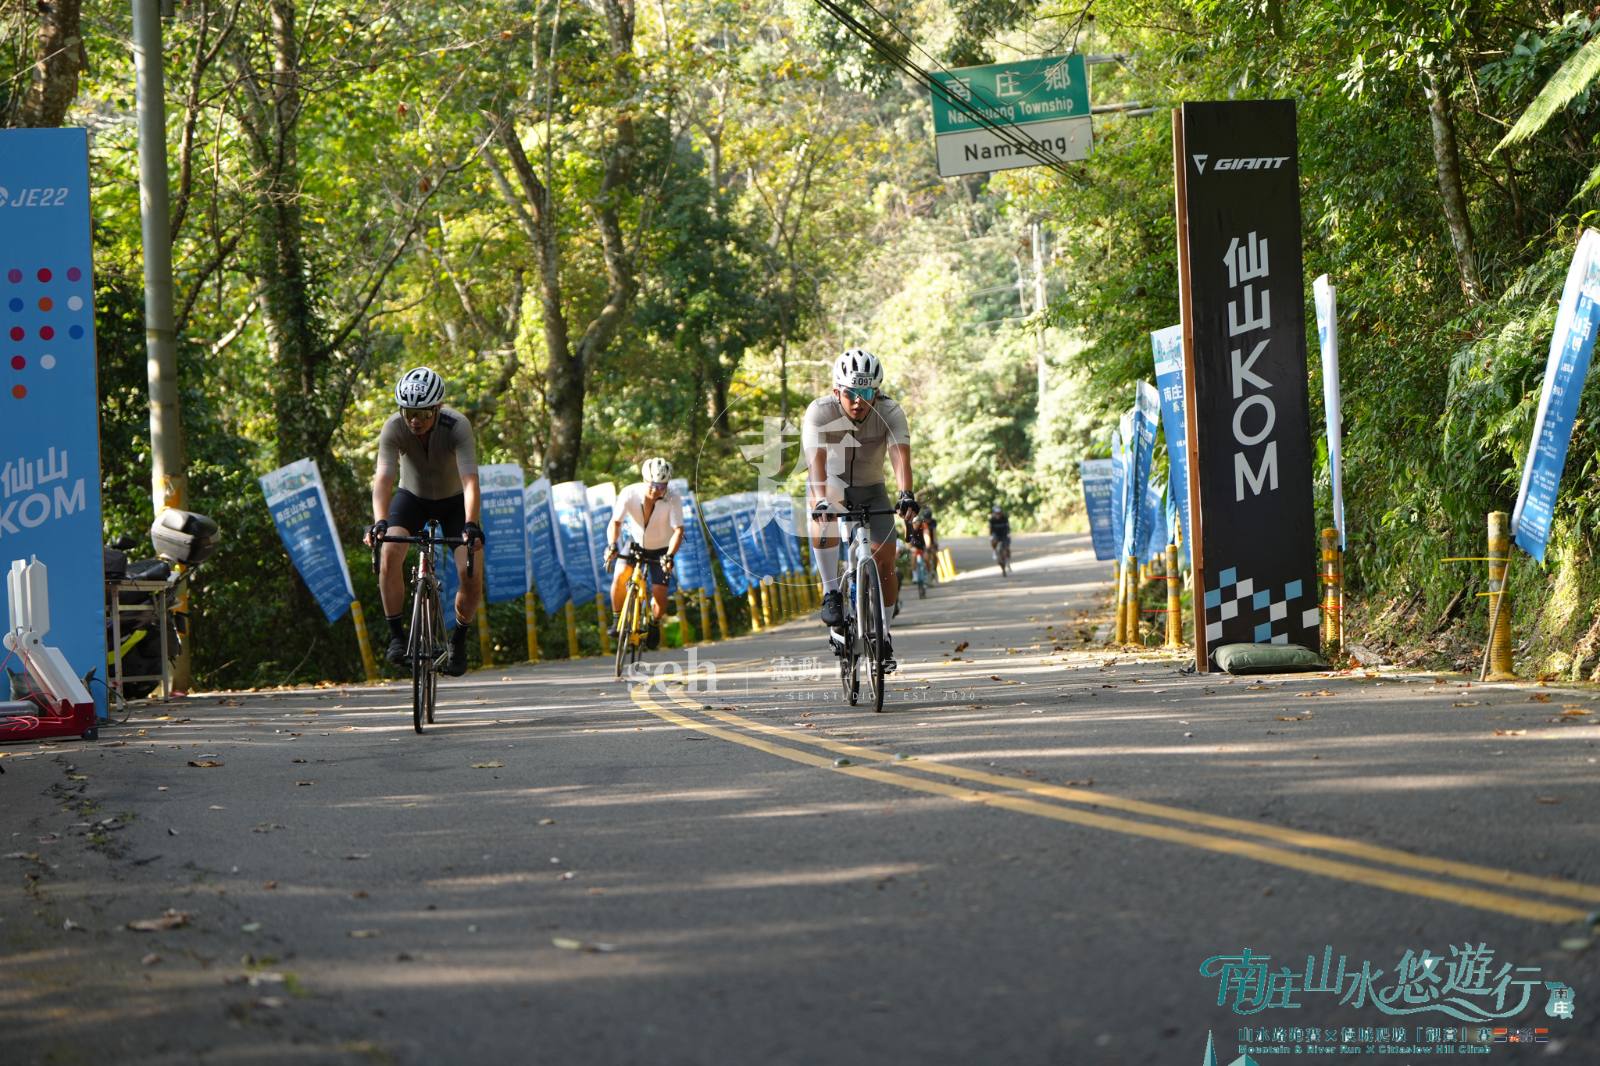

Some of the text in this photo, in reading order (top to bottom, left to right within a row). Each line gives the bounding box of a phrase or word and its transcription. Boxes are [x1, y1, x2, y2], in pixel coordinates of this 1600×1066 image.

[1018, 96, 1074, 115] Township
[1213, 156, 1290, 171] GIANT
[11, 187, 68, 207] JE22
[1222, 231, 1271, 337] 仙山
[1230, 338, 1279, 502] KOM
[0, 446, 68, 498] 仙山
[0, 478, 86, 538] KOM
